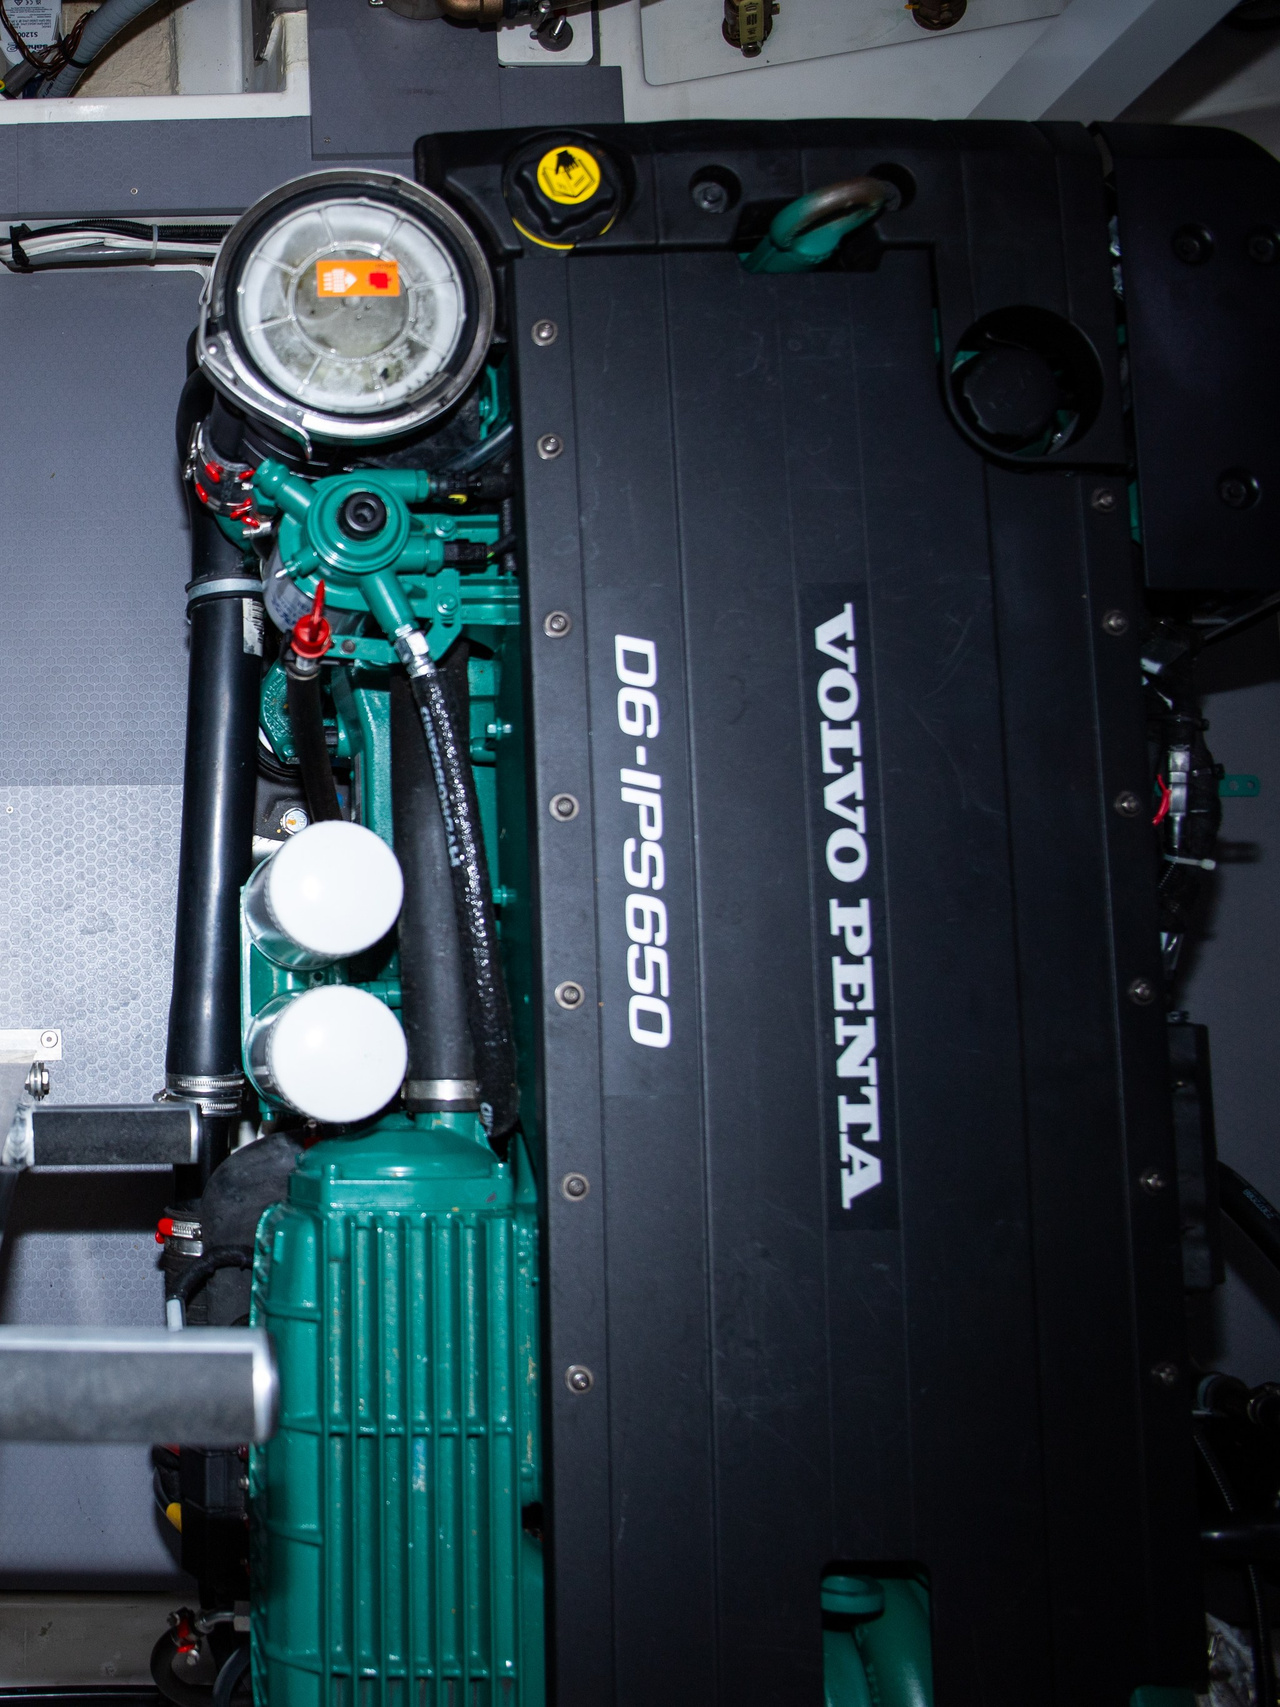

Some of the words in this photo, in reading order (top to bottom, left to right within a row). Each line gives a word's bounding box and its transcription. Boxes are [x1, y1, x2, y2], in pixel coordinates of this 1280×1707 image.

[614, 634, 671, 1050] D6-IPS650
[814, 602, 871, 883] VOLVO
[828, 898, 883, 1211] PENTA
